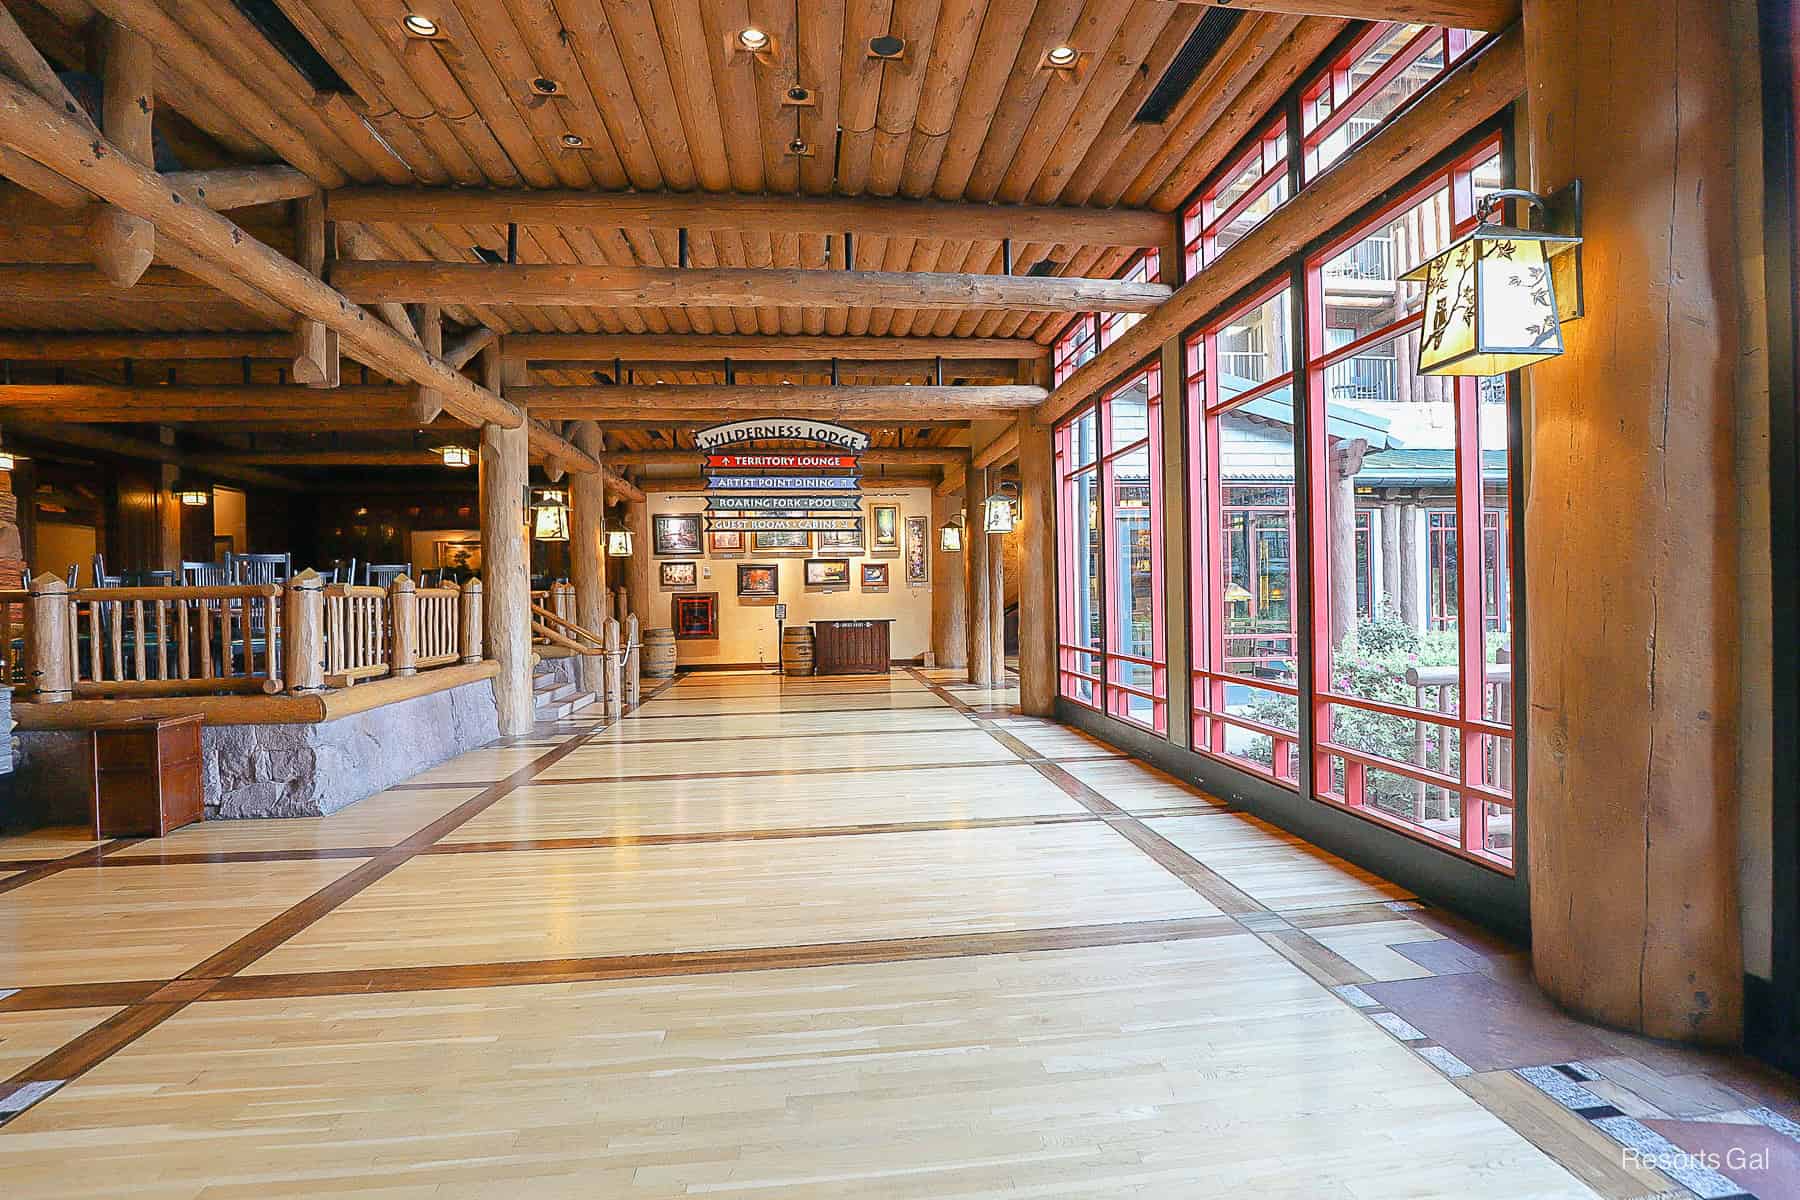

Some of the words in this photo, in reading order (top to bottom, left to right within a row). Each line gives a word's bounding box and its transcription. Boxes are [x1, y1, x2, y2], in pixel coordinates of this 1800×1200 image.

[704, 425, 801, 446] WILDERNESS
[808, 427, 859, 448] LODGE
[734, 456, 795, 466] TERRITORY
[797, 456, 841, 466] LOUNGE
[718, 478, 756, 488] ARTIST
[758, 478, 792, 488] POINT
[795, 478, 834, 488] DINING
[719, 498, 770, 508] ROARING
[773, 498, 801, 508] FORK
[809, 498, 836, 508] POOL
[715, 521, 747, 531] GUEST
[751, 521, 791, 531] ROOMS
[798, 521, 836, 531] CABINS
